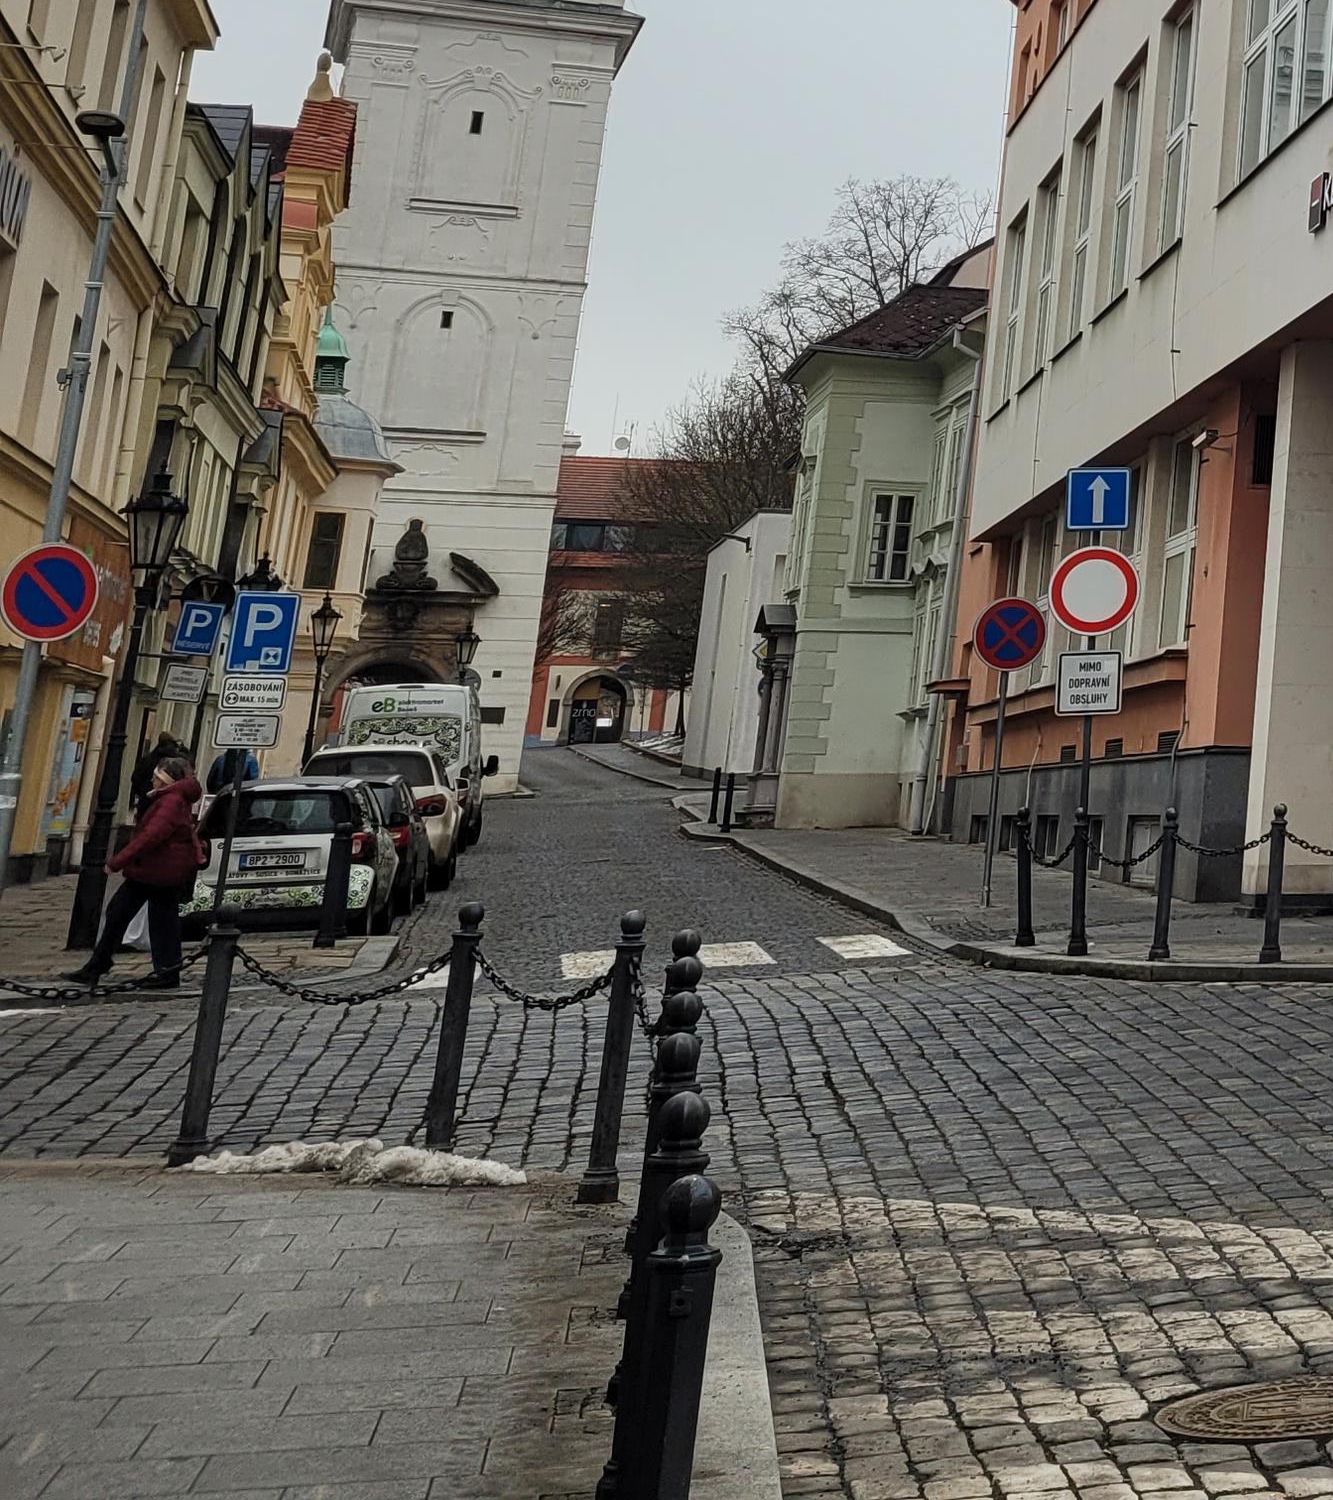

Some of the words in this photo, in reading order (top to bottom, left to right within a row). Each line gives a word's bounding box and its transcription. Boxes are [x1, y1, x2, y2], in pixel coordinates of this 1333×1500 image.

[185, 608, 213, 638] P
[243, 603, 284, 648] P
[1079, 661, 1102, 673] MIMO
[226, 680, 284, 692] ZÁSOBOVÁNÍ
[1068, 674, 1112, 689] DOPRAVNÍ
[1069, 693, 1109, 706] OBSLUHY
[274, 854, 301, 865] 2900
